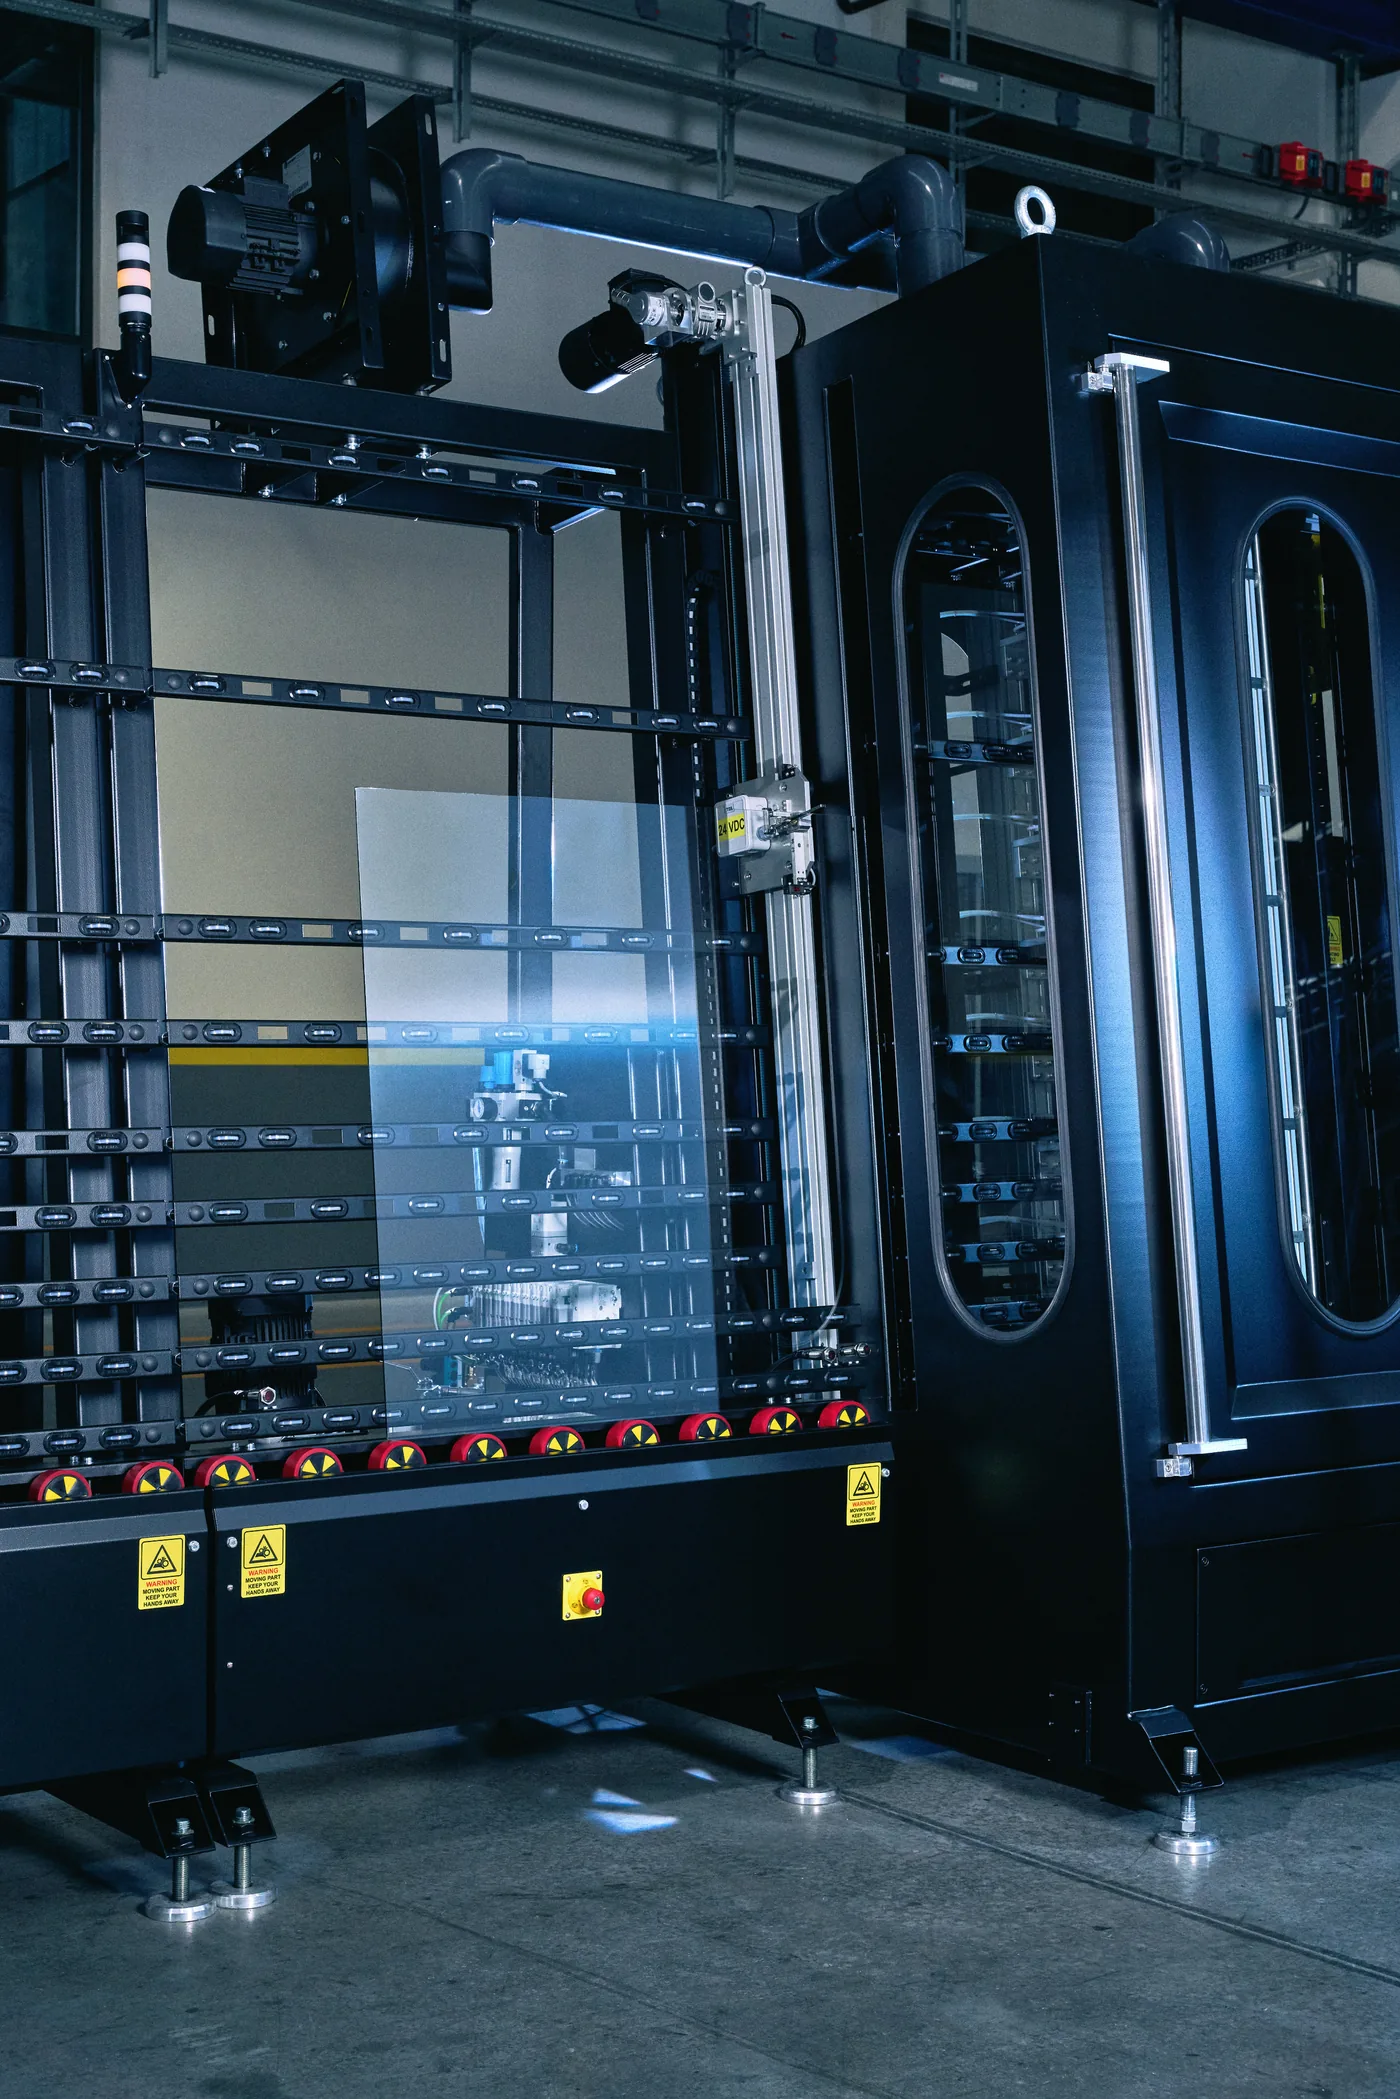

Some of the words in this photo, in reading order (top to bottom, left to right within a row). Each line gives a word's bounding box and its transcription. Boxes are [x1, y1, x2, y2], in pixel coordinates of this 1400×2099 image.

[718, 824, 727, 836] 24
[728, 818, 745, 833] VDC
[248, 1567, 279, 1576] WARNING
[146, 1579, 178, 1587] WARNING
[245, 1575, 267, 1583] MOVING
[246, 1588, 265, 1596] HANDS
